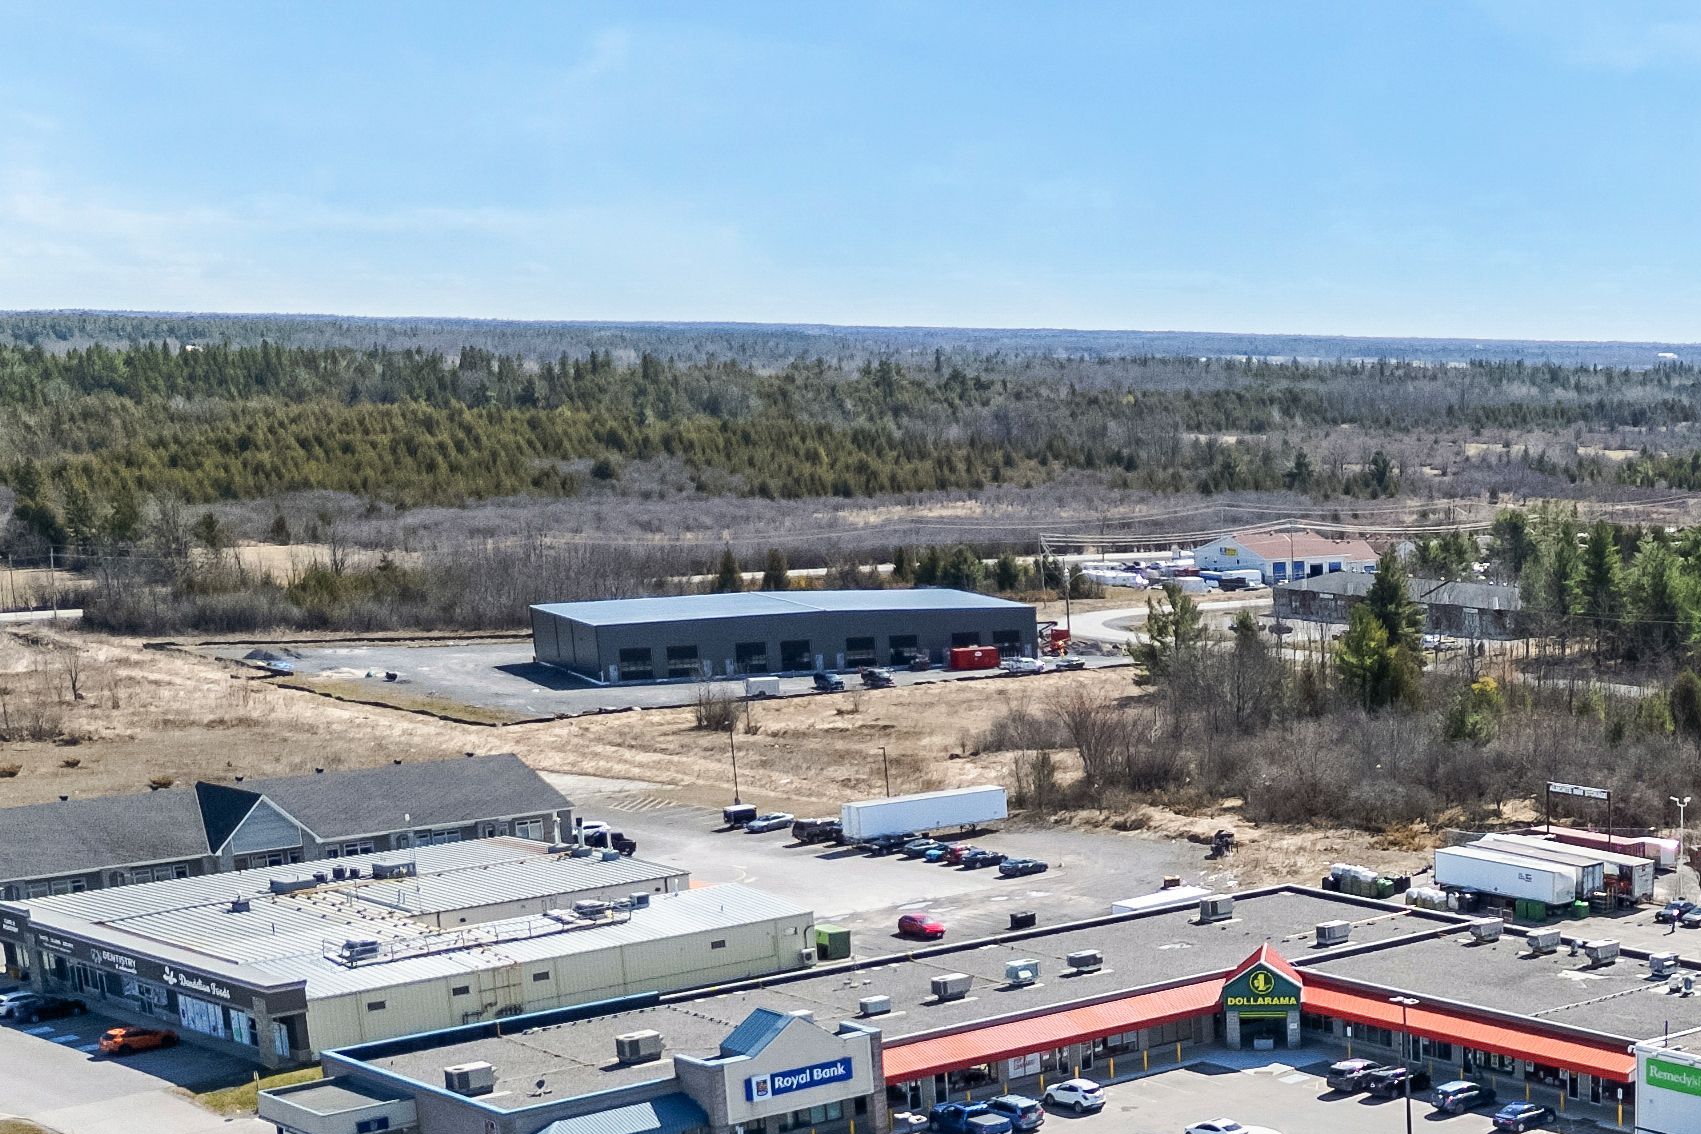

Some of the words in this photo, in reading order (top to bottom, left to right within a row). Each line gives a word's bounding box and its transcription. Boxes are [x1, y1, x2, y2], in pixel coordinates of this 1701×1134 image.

[1227, 996, 1297, 1006] DOLLARAMA
[774, 1069, 810, 1089] Royal
[813, 1062, 846, 1080] Bank
